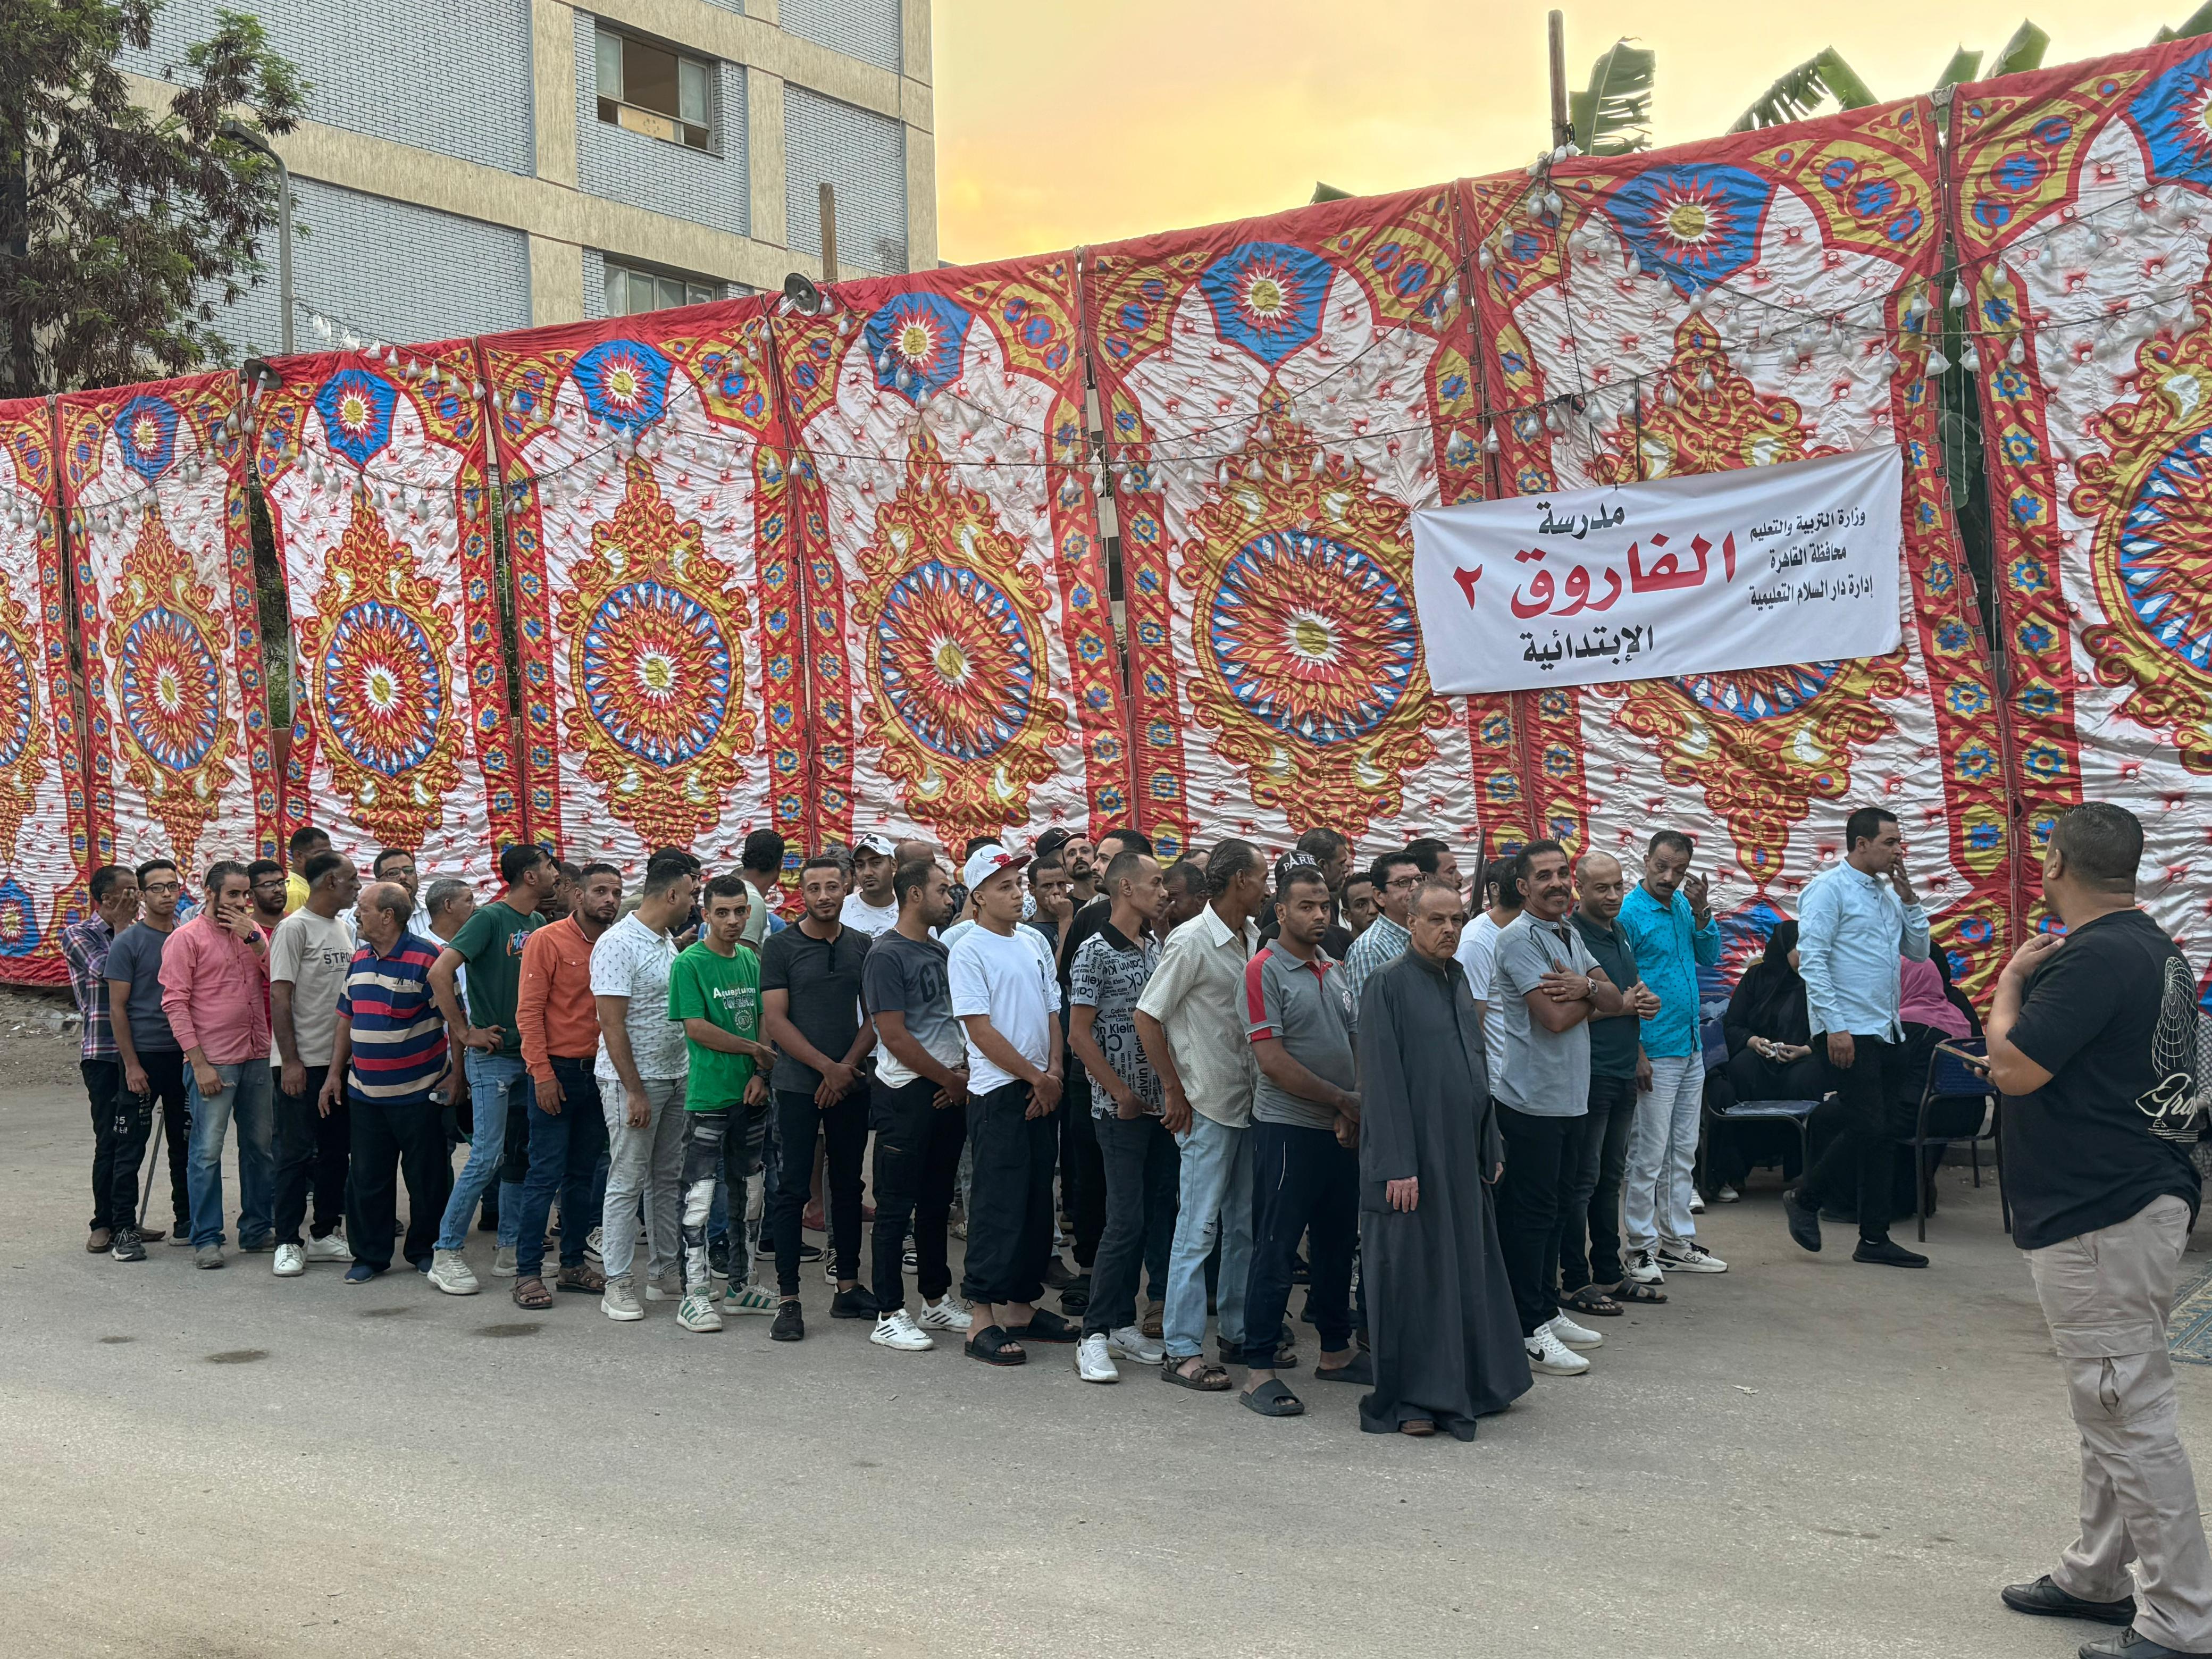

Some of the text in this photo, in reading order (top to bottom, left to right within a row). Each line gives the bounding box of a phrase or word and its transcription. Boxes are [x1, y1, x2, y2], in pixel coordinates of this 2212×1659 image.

[1536, 501, 1625, 540] مدرسة
[1750, 507, 1865, 542] وزارة التربية والتعليم
[1453, 530, 1736, 619] الفاروق ٢
[1769, 541, 1847, 574] محافظة القاهرة
[1749, 574, 1873, 611] إدارة دار السلام التعليمية
[1519, 624, 1653, 671] الإبتدائية
[323, 952, 351, 965] STRO
[1109, 1023, 1136, 1034] Klein
[1683, 1252, 1703, 1264] EA7
